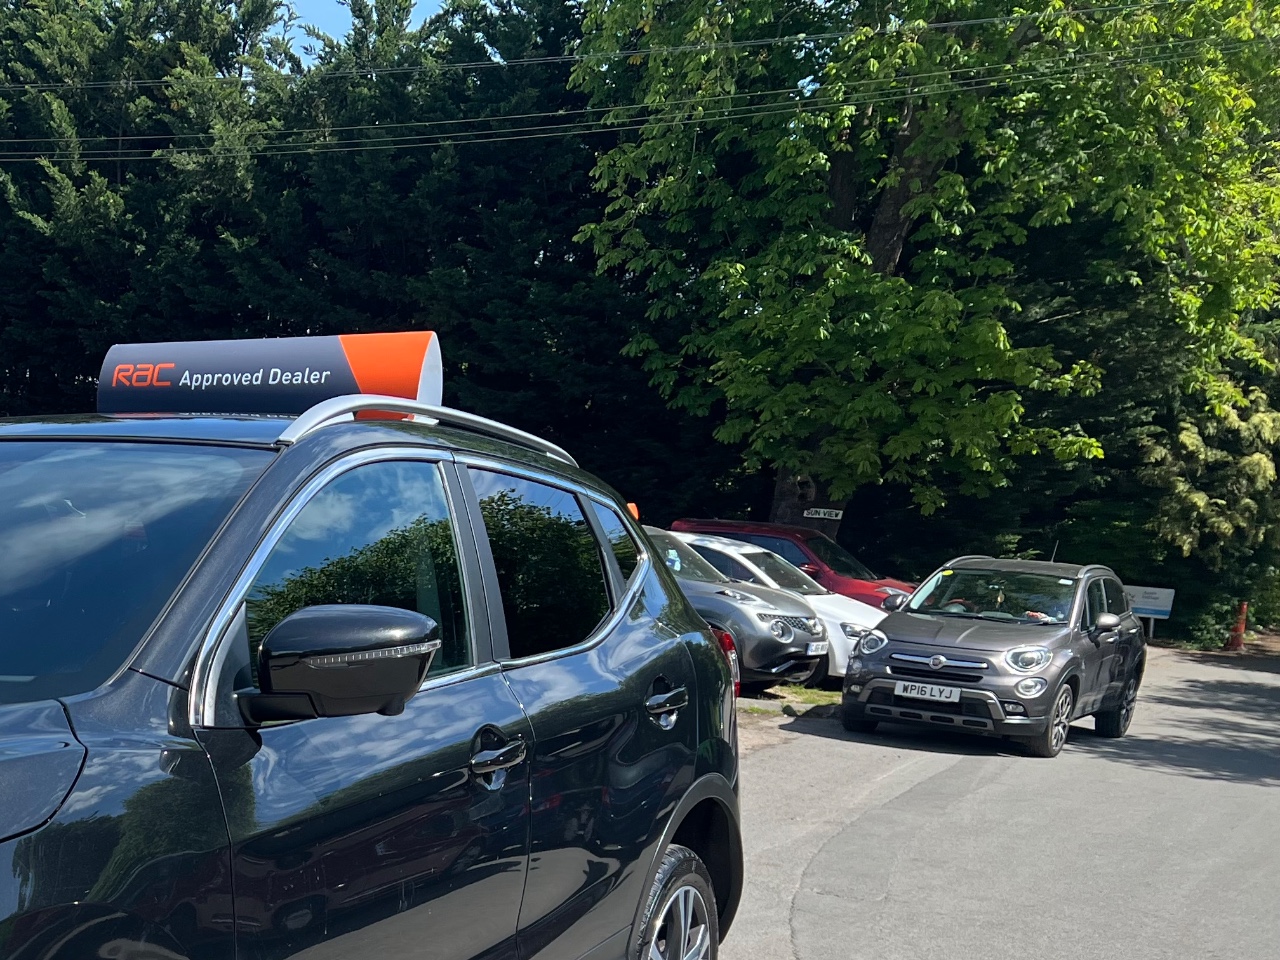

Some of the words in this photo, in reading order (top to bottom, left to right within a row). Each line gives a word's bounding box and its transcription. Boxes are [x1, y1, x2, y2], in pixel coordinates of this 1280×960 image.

[112, 362, 175, 387] RAC
[178, 368, 263, 390] Approved
[269, 367, 331, 385] Dealer
[823, 510, 841, 518] VIEW
[902, 684, 928, 696] WP16
[929, 687, 953, 699] LYJ
